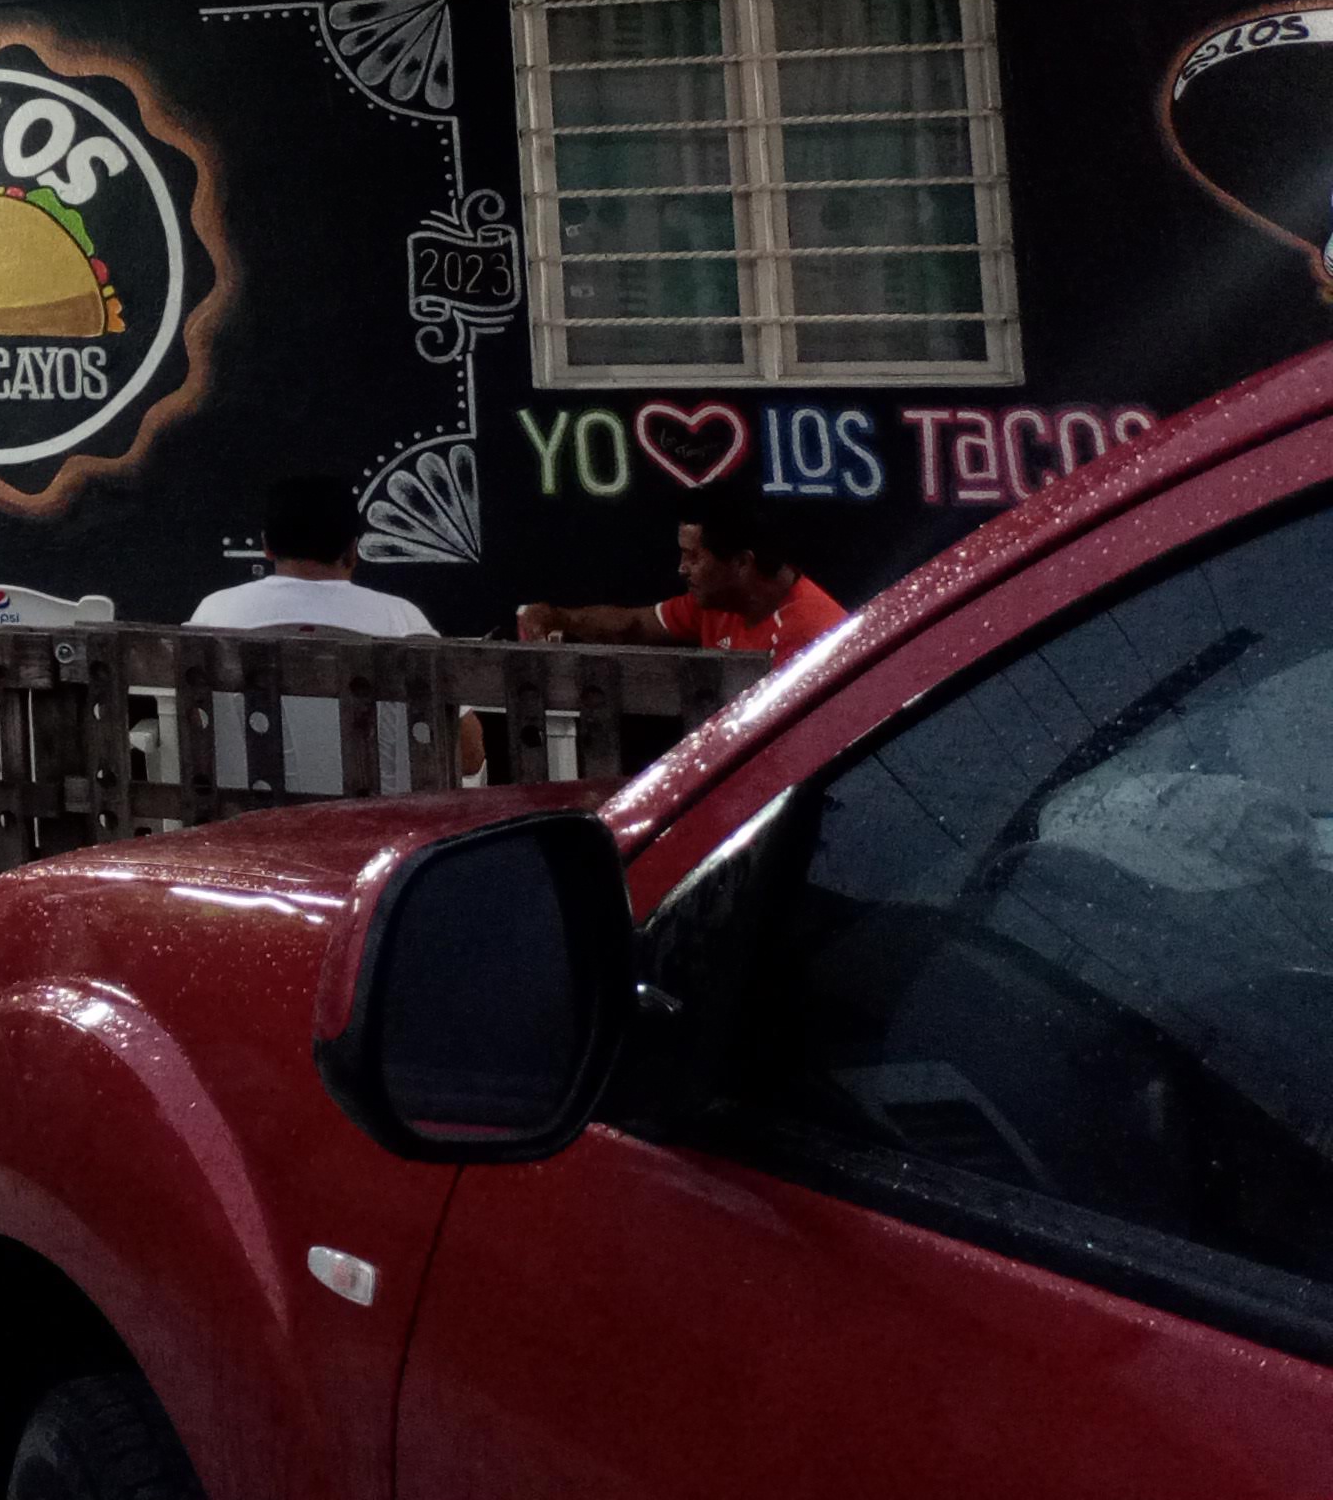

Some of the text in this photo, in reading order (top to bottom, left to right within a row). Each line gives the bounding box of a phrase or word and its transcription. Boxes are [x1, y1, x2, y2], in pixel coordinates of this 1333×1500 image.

[419, 247, 512, 297] 2023
[518, 408, 631, 495] YO
[761, 406, 882, 497] LOS
